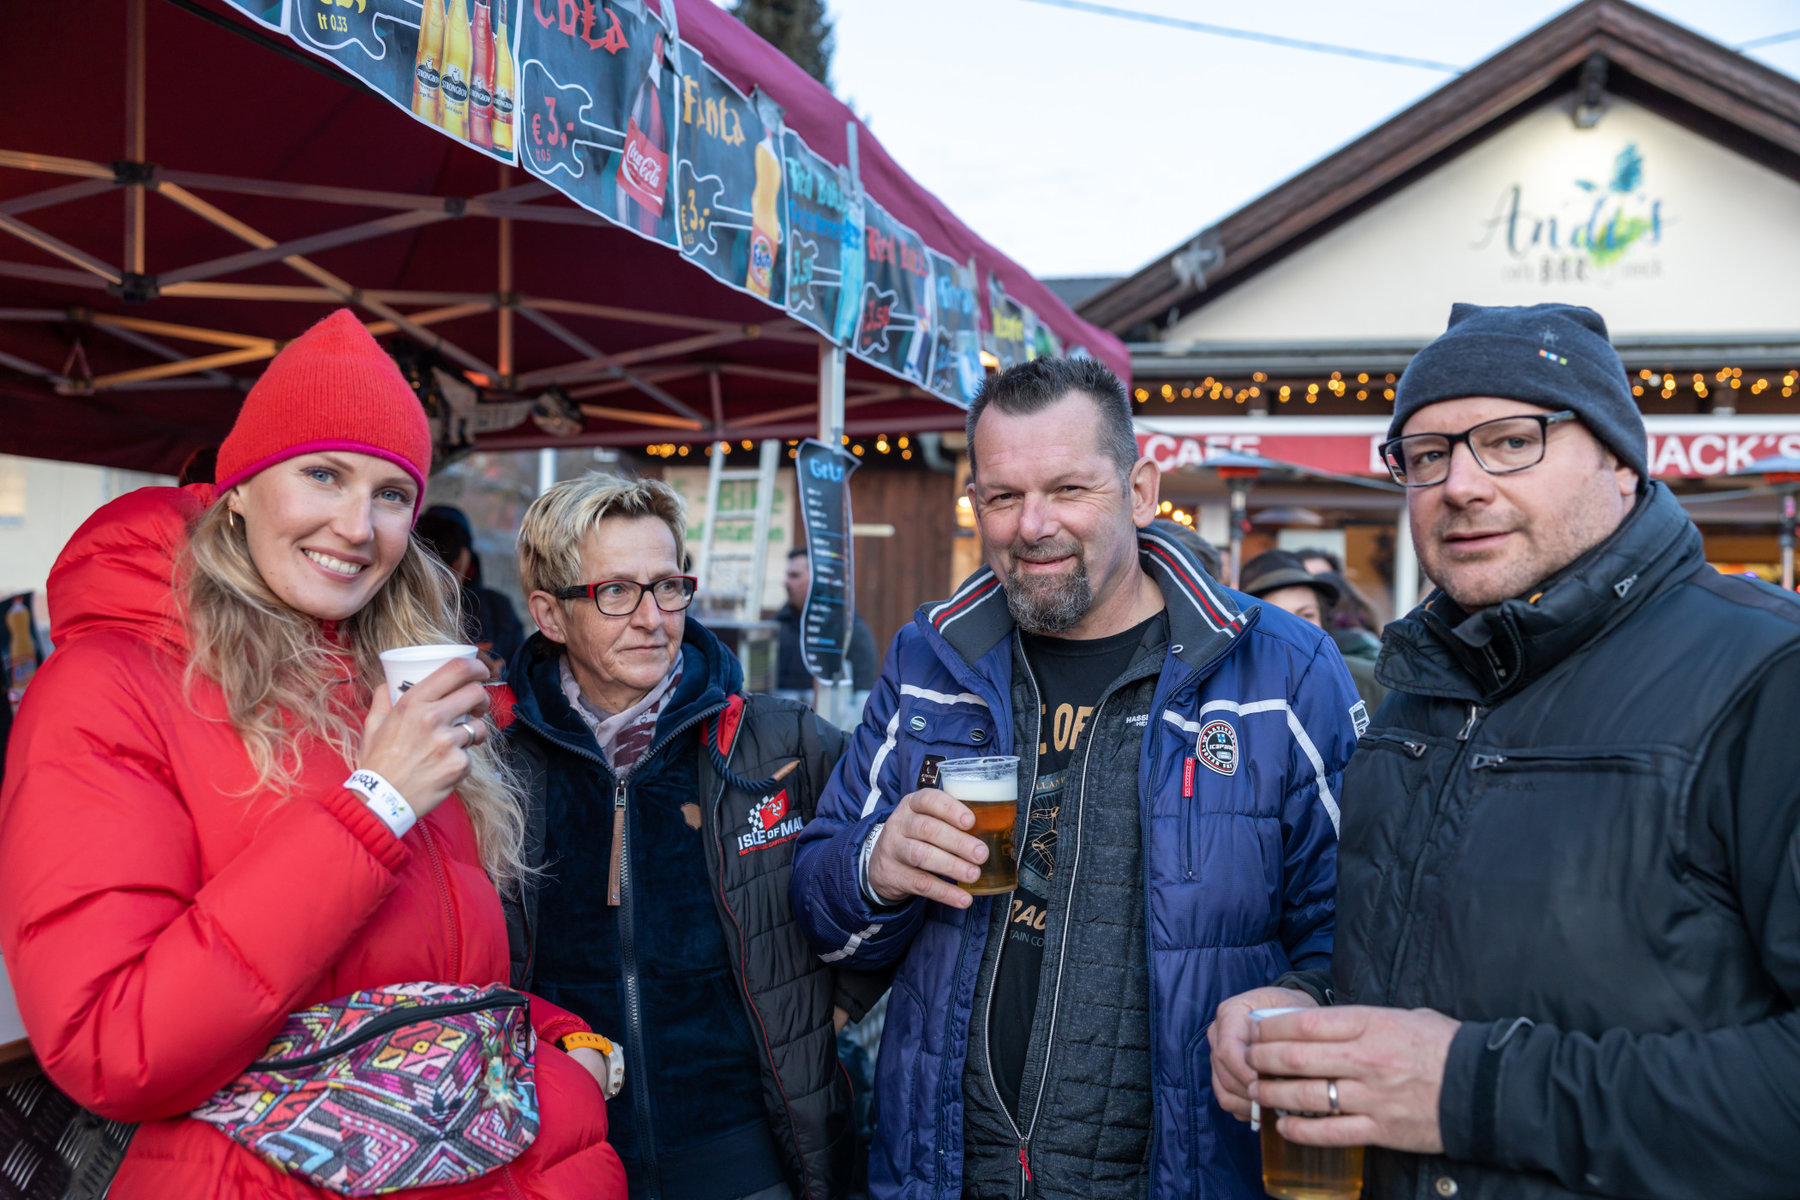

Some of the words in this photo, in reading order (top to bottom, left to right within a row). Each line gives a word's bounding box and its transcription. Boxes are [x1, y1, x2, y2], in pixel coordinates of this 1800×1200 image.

[1053, 702, 1095, 752] OF
[737, 830, 767, 851] ISLE
[767, 827, 780, 839] OF
